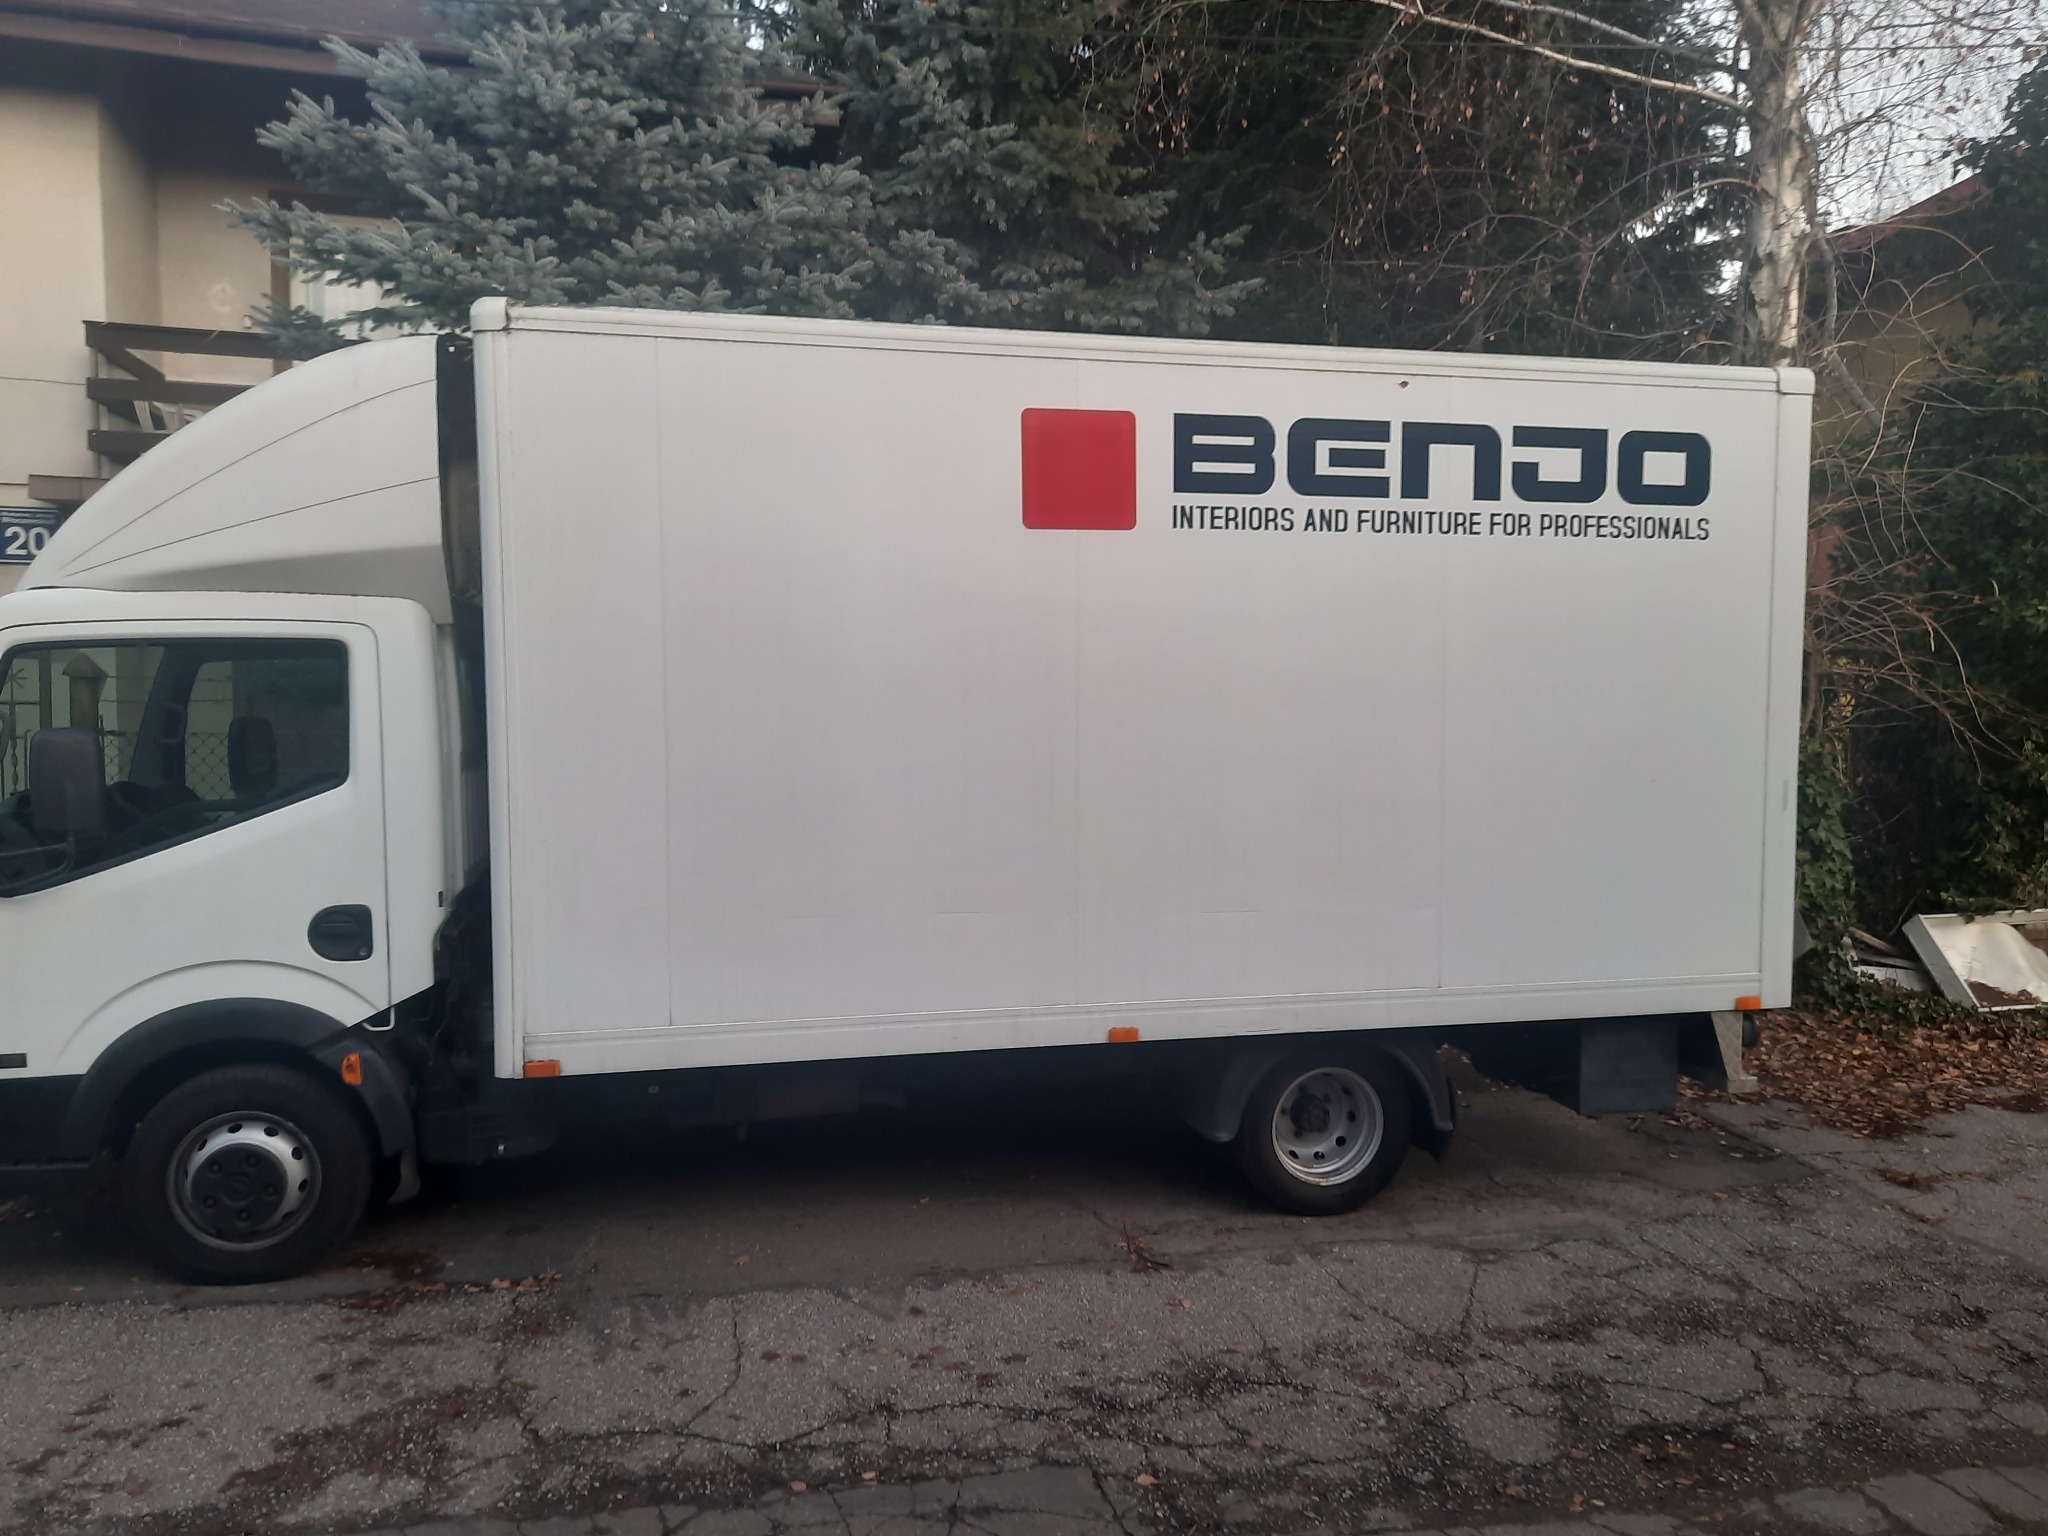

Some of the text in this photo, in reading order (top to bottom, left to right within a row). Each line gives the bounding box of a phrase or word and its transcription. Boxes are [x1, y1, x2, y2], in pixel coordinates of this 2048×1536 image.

[1172, 503, 1711, 542] INTERIORS AND FURNITURE FOR PROFESSIONALS
[4, 526, 50, 555] 20
